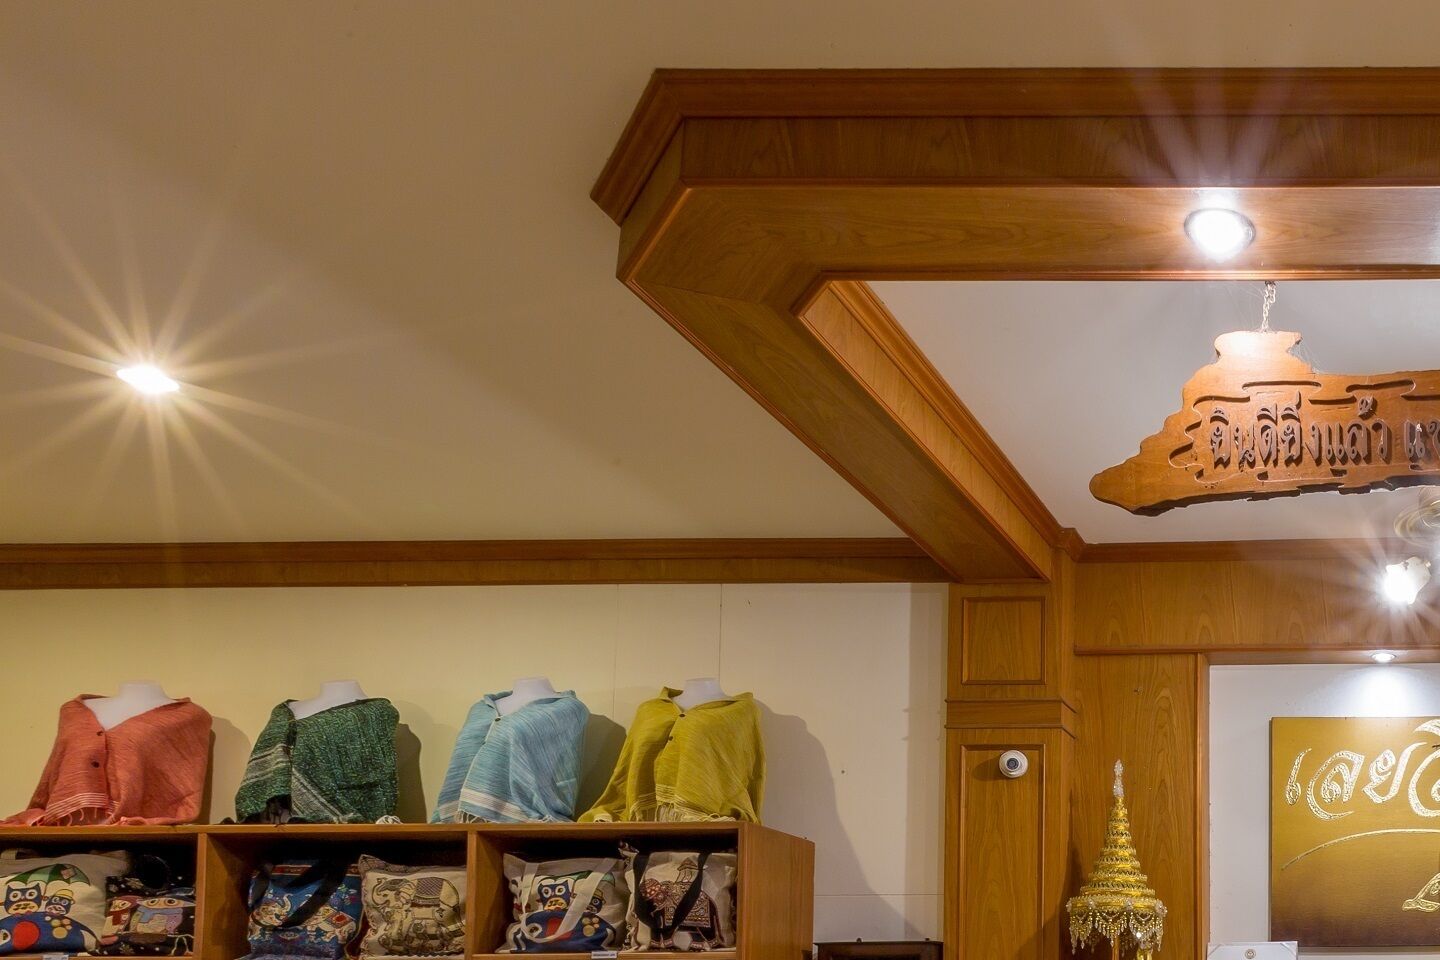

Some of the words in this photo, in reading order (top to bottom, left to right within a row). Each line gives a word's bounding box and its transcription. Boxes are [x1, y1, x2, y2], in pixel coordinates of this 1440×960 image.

[1209, 391, 1390, 471] ยินดียิ่งแล้ว
